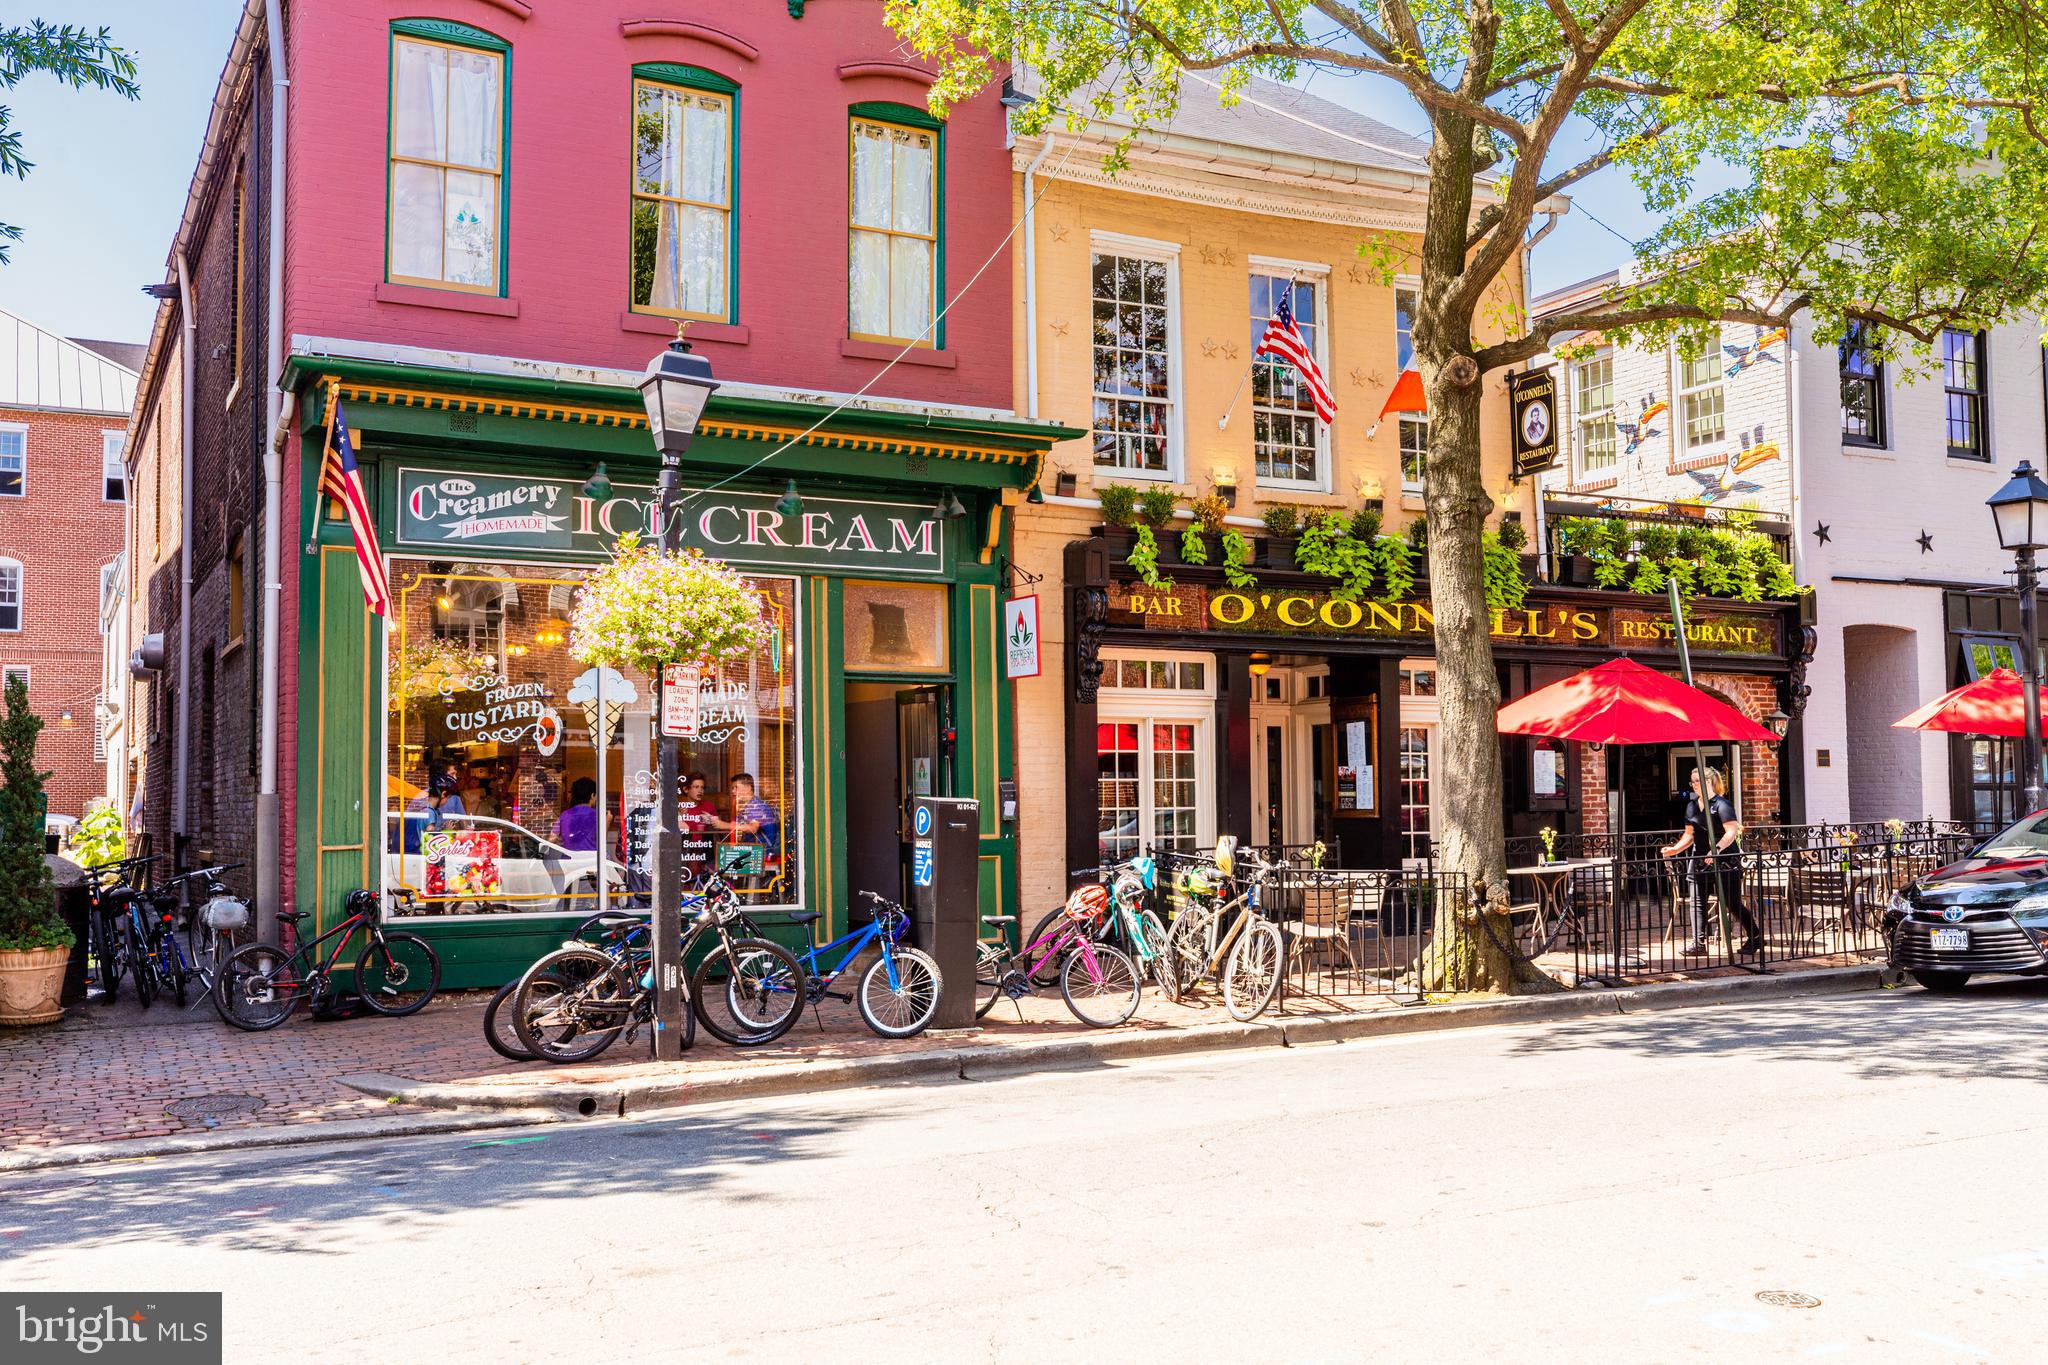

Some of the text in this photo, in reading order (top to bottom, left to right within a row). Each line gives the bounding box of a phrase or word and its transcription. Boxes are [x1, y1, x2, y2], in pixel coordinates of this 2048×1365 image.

[1516, 382, 1552, 403] O'CONNELL'S
[1519, 445, 1554, 461] RESTAURANT
[444, 482, 472, 491] The
[409, 483, 562, 521] Creamery
[465, 518, 543, 535] HOMEMADE
[698, 504, 938, 555] CREAM
[1129, 593, 1756, 645] BAR O'CONNLL'S RESTURANT
[485, 683, 544, 705] FROZEN
[669, 687, 694, 695] LOADING
[446, 700, 544, 731] CUSTARD
[427, 835, 474, 863] Sorbet
[683, 840, 713, 848] Sorbet
